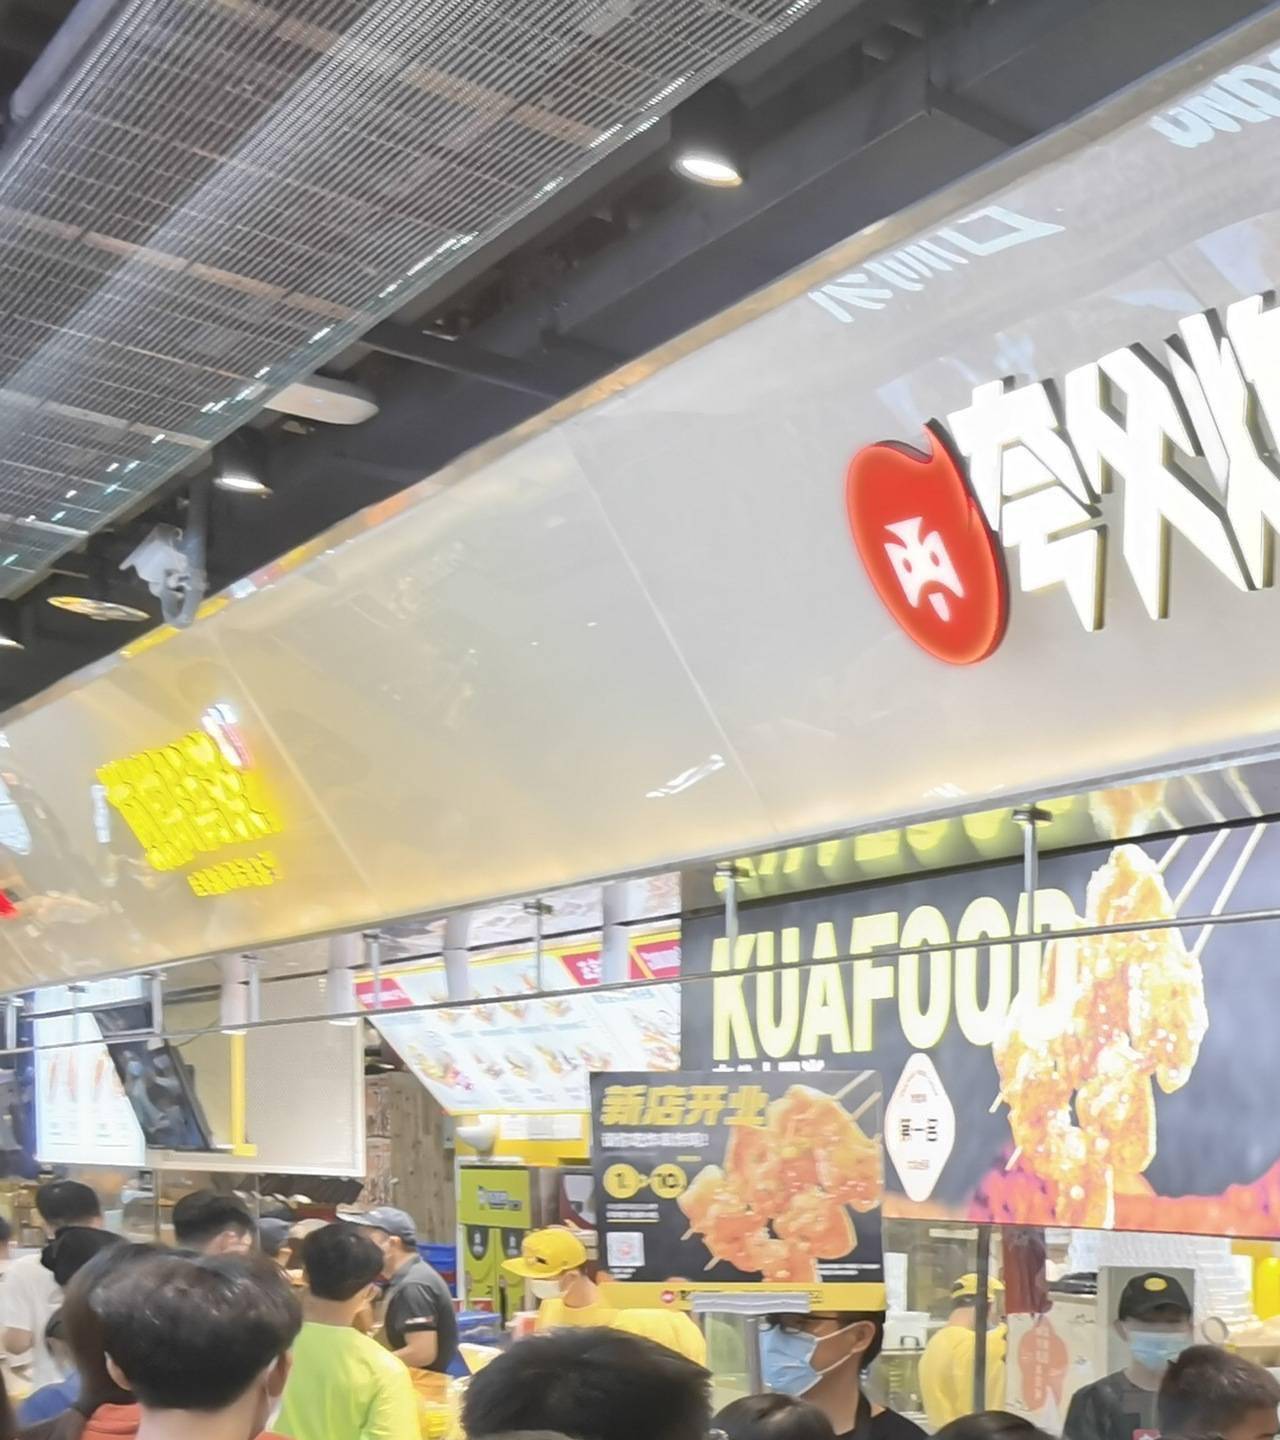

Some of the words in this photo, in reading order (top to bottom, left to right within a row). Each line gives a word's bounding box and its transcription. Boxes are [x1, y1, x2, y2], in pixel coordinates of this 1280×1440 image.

[711, 888, 1086, 1060] KUAFOOD
[600, 1085, 768, 1126] 新店开业
